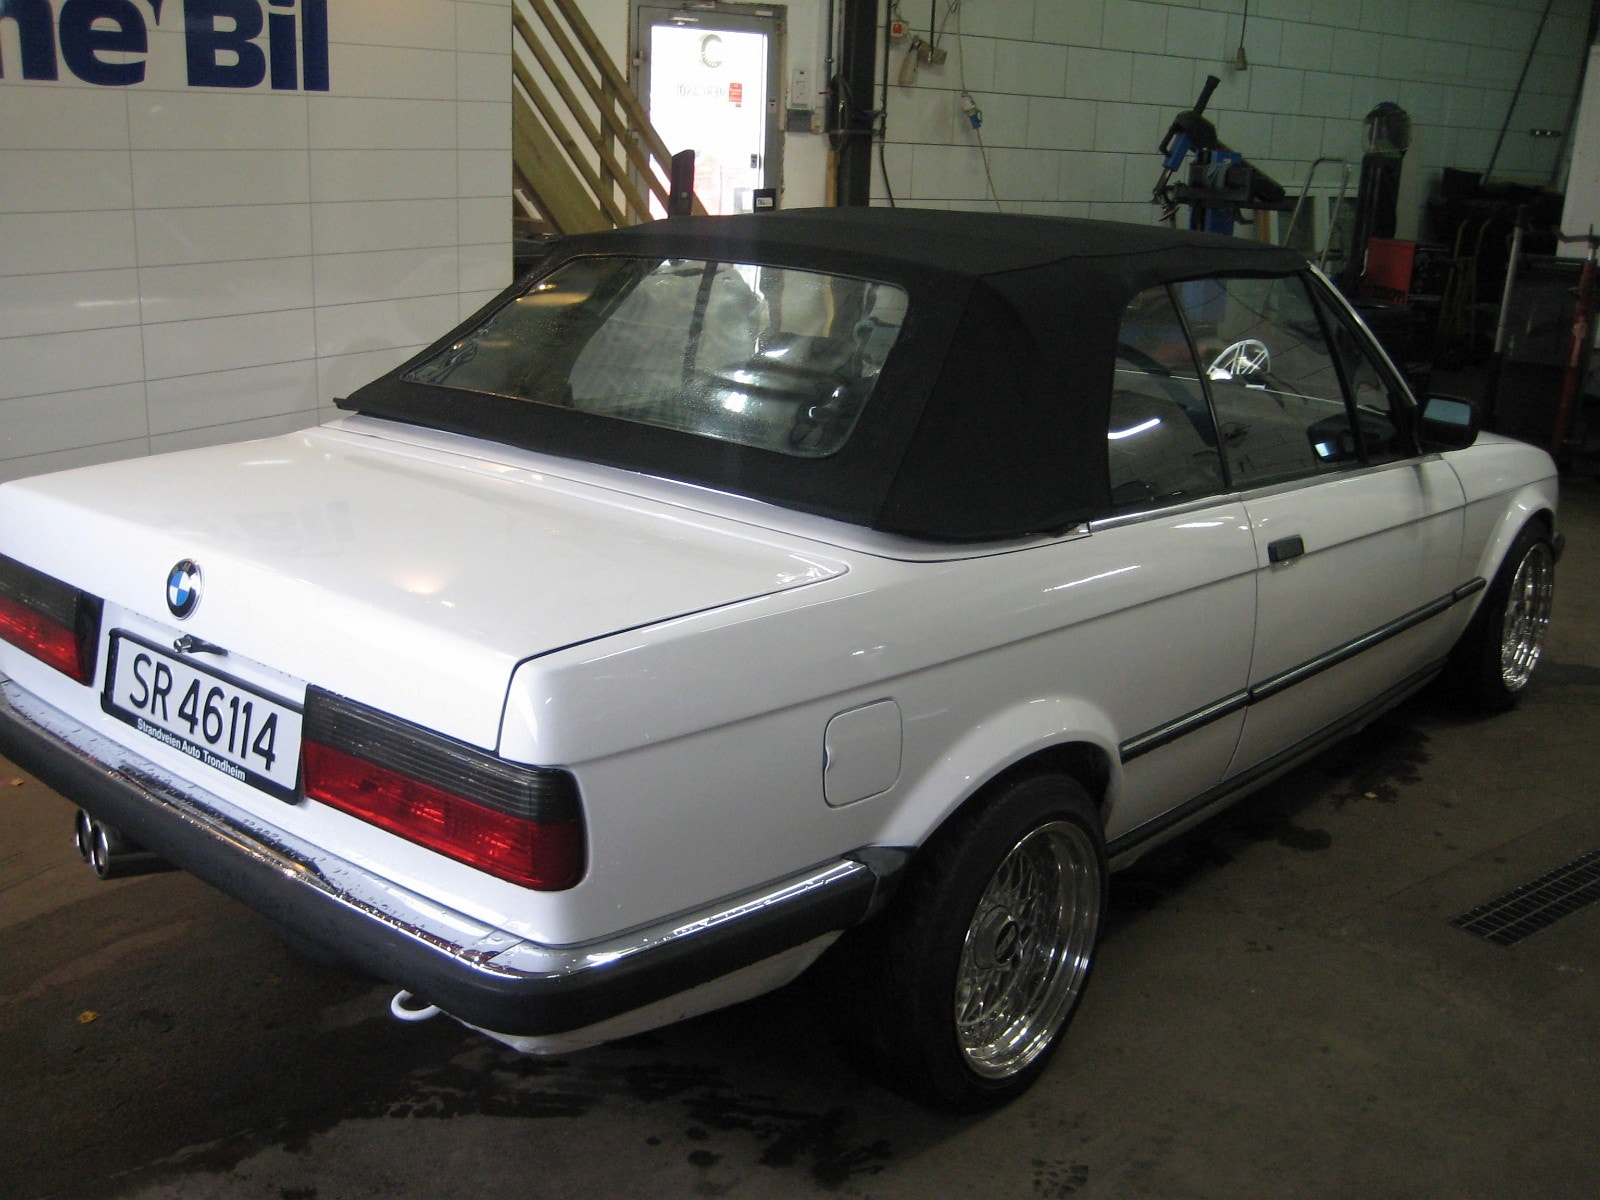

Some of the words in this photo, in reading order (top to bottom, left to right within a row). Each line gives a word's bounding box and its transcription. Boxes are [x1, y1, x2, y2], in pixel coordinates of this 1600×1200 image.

[184, 0, 330, 91] Bil
[129, 653, 173, 722] SR
[178, 678, 278, 772] 46114
[137, 718, 182, 751] Strandveien
[181, 740, 201, 759] Auto
[203, 750, 246, 782] Trondheim
